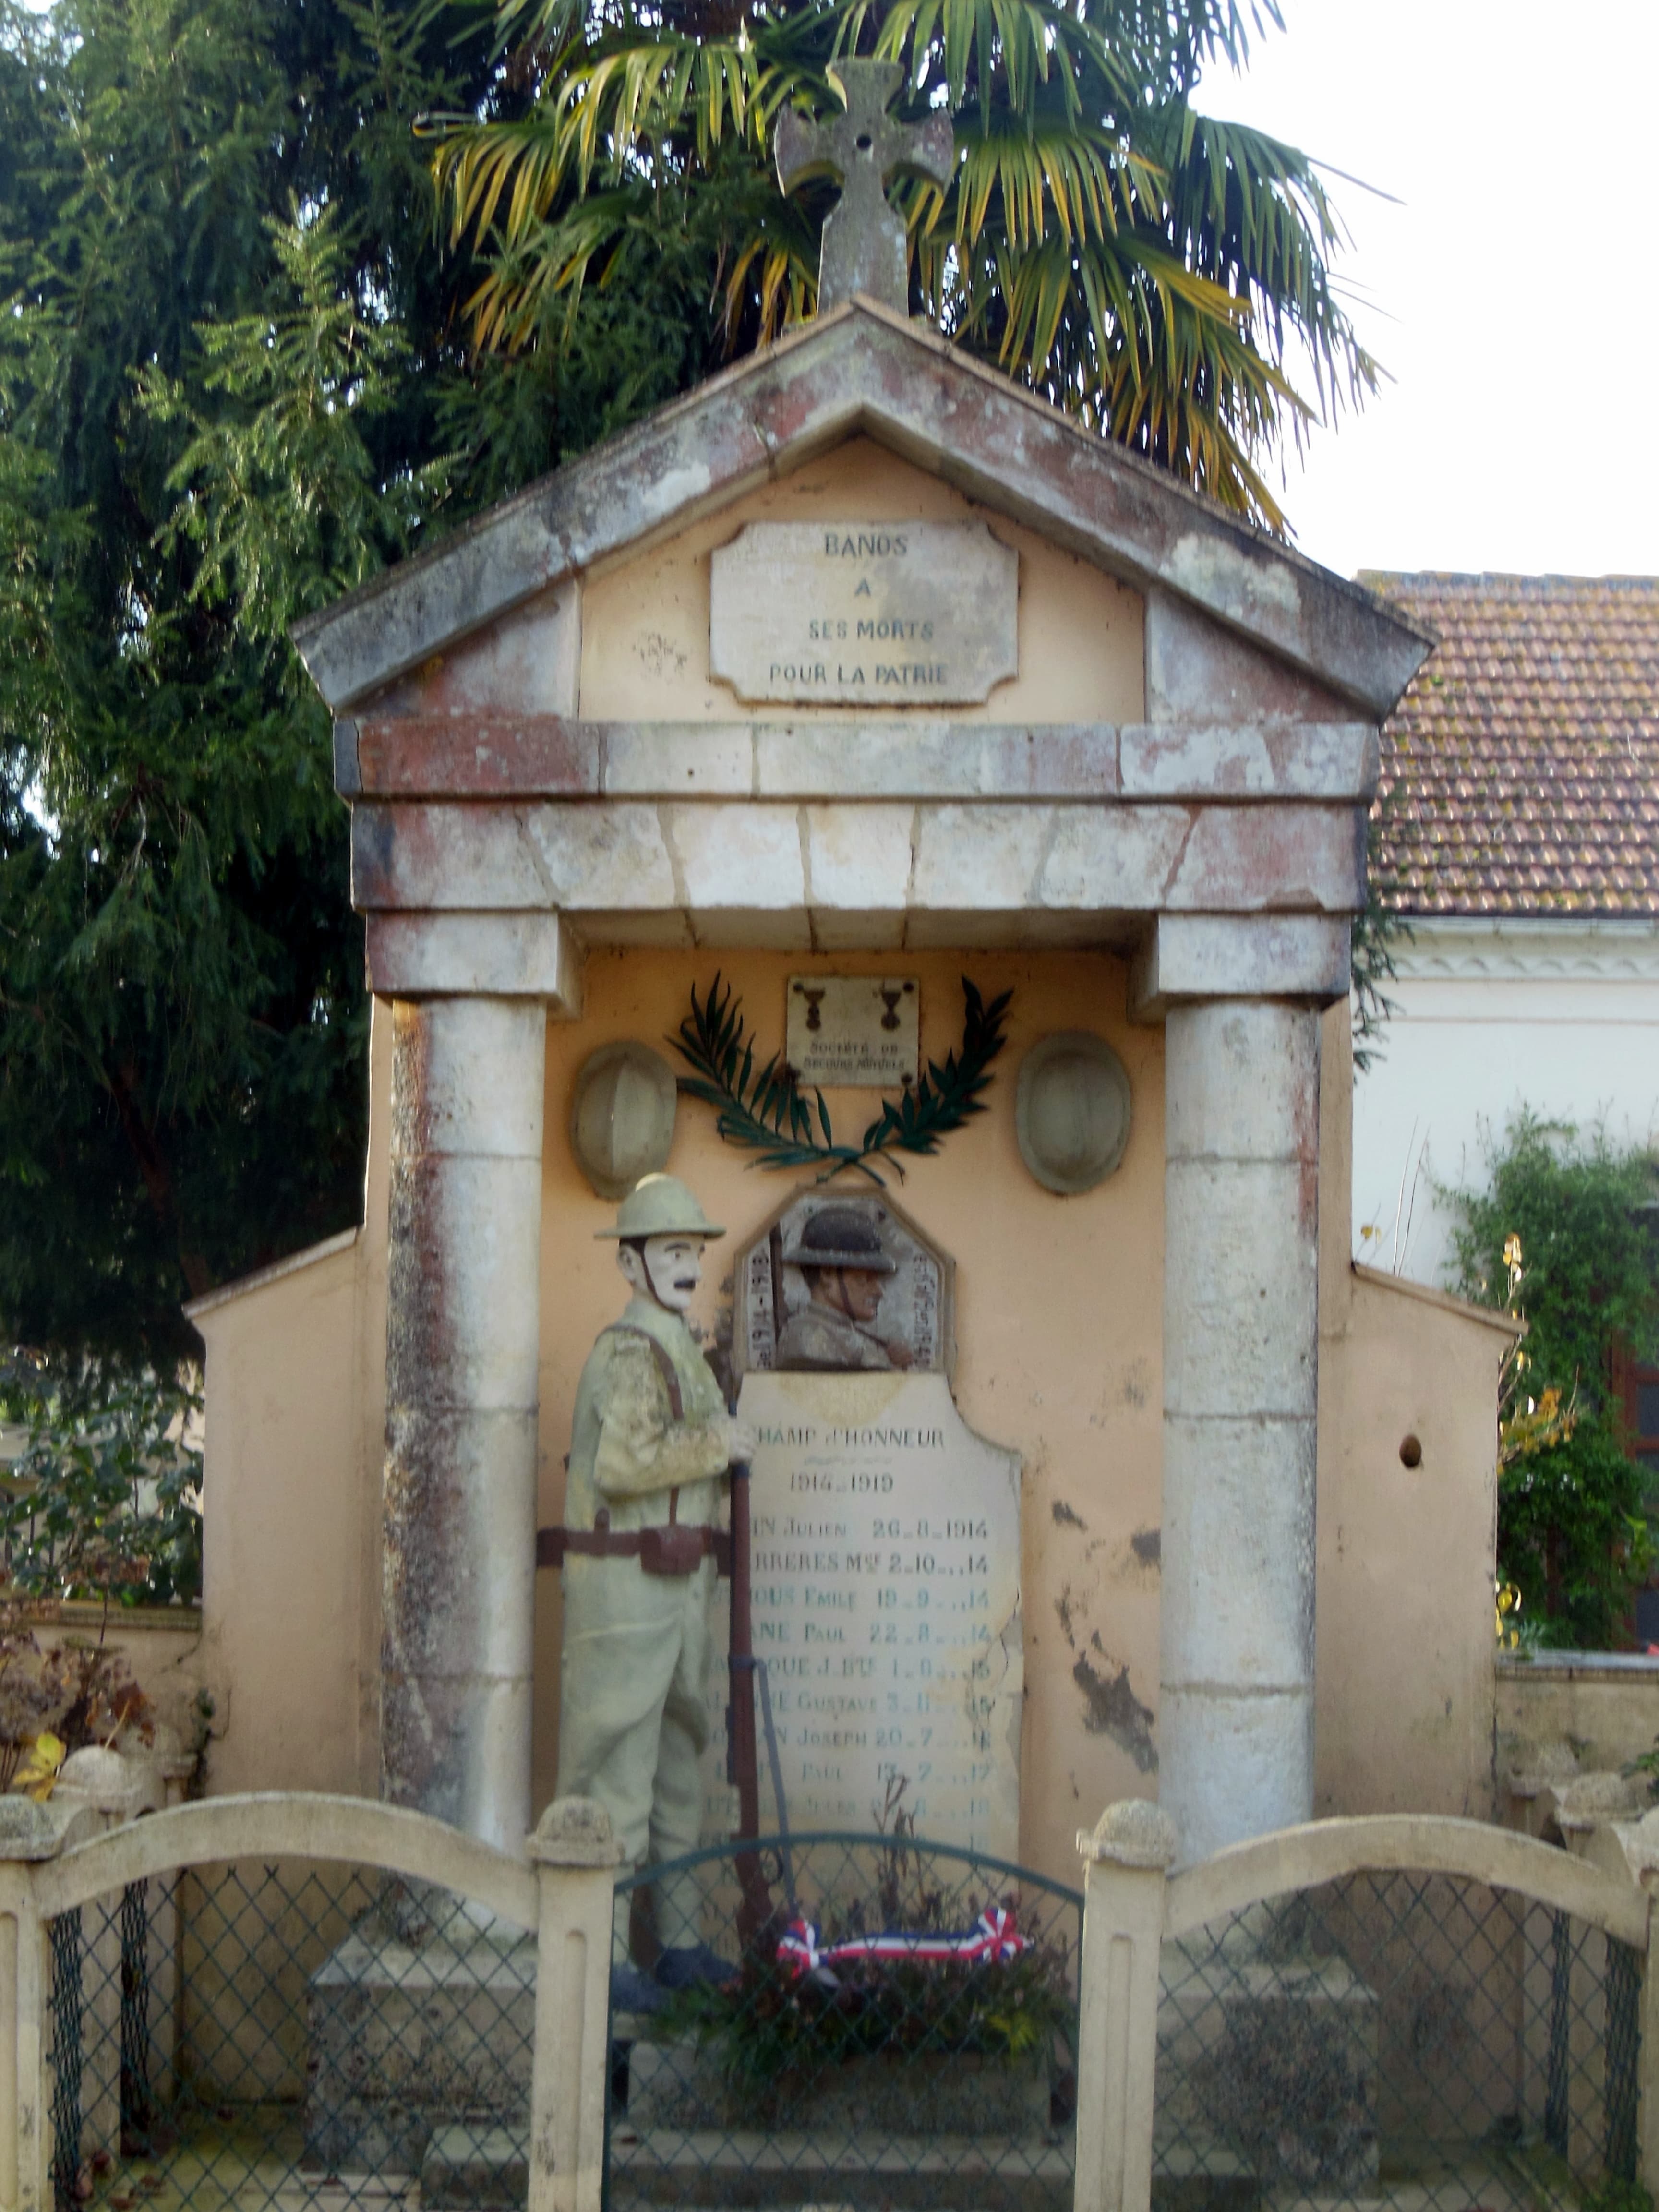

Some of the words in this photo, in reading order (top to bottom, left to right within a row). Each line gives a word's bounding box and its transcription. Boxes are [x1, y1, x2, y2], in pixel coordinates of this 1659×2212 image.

[825, 533, 908, 558] BANOS
[854, 578, 872, 598] A
[809, 619, 848, 641] SES
[856, 620, 935, 642] MORTS
[770, 663, 827, 685] POUR
[837, 663, 865, 685] LA
[875, 663, 950, 686] PATRIE
[805, 1621, 845, 1642] PAUL
